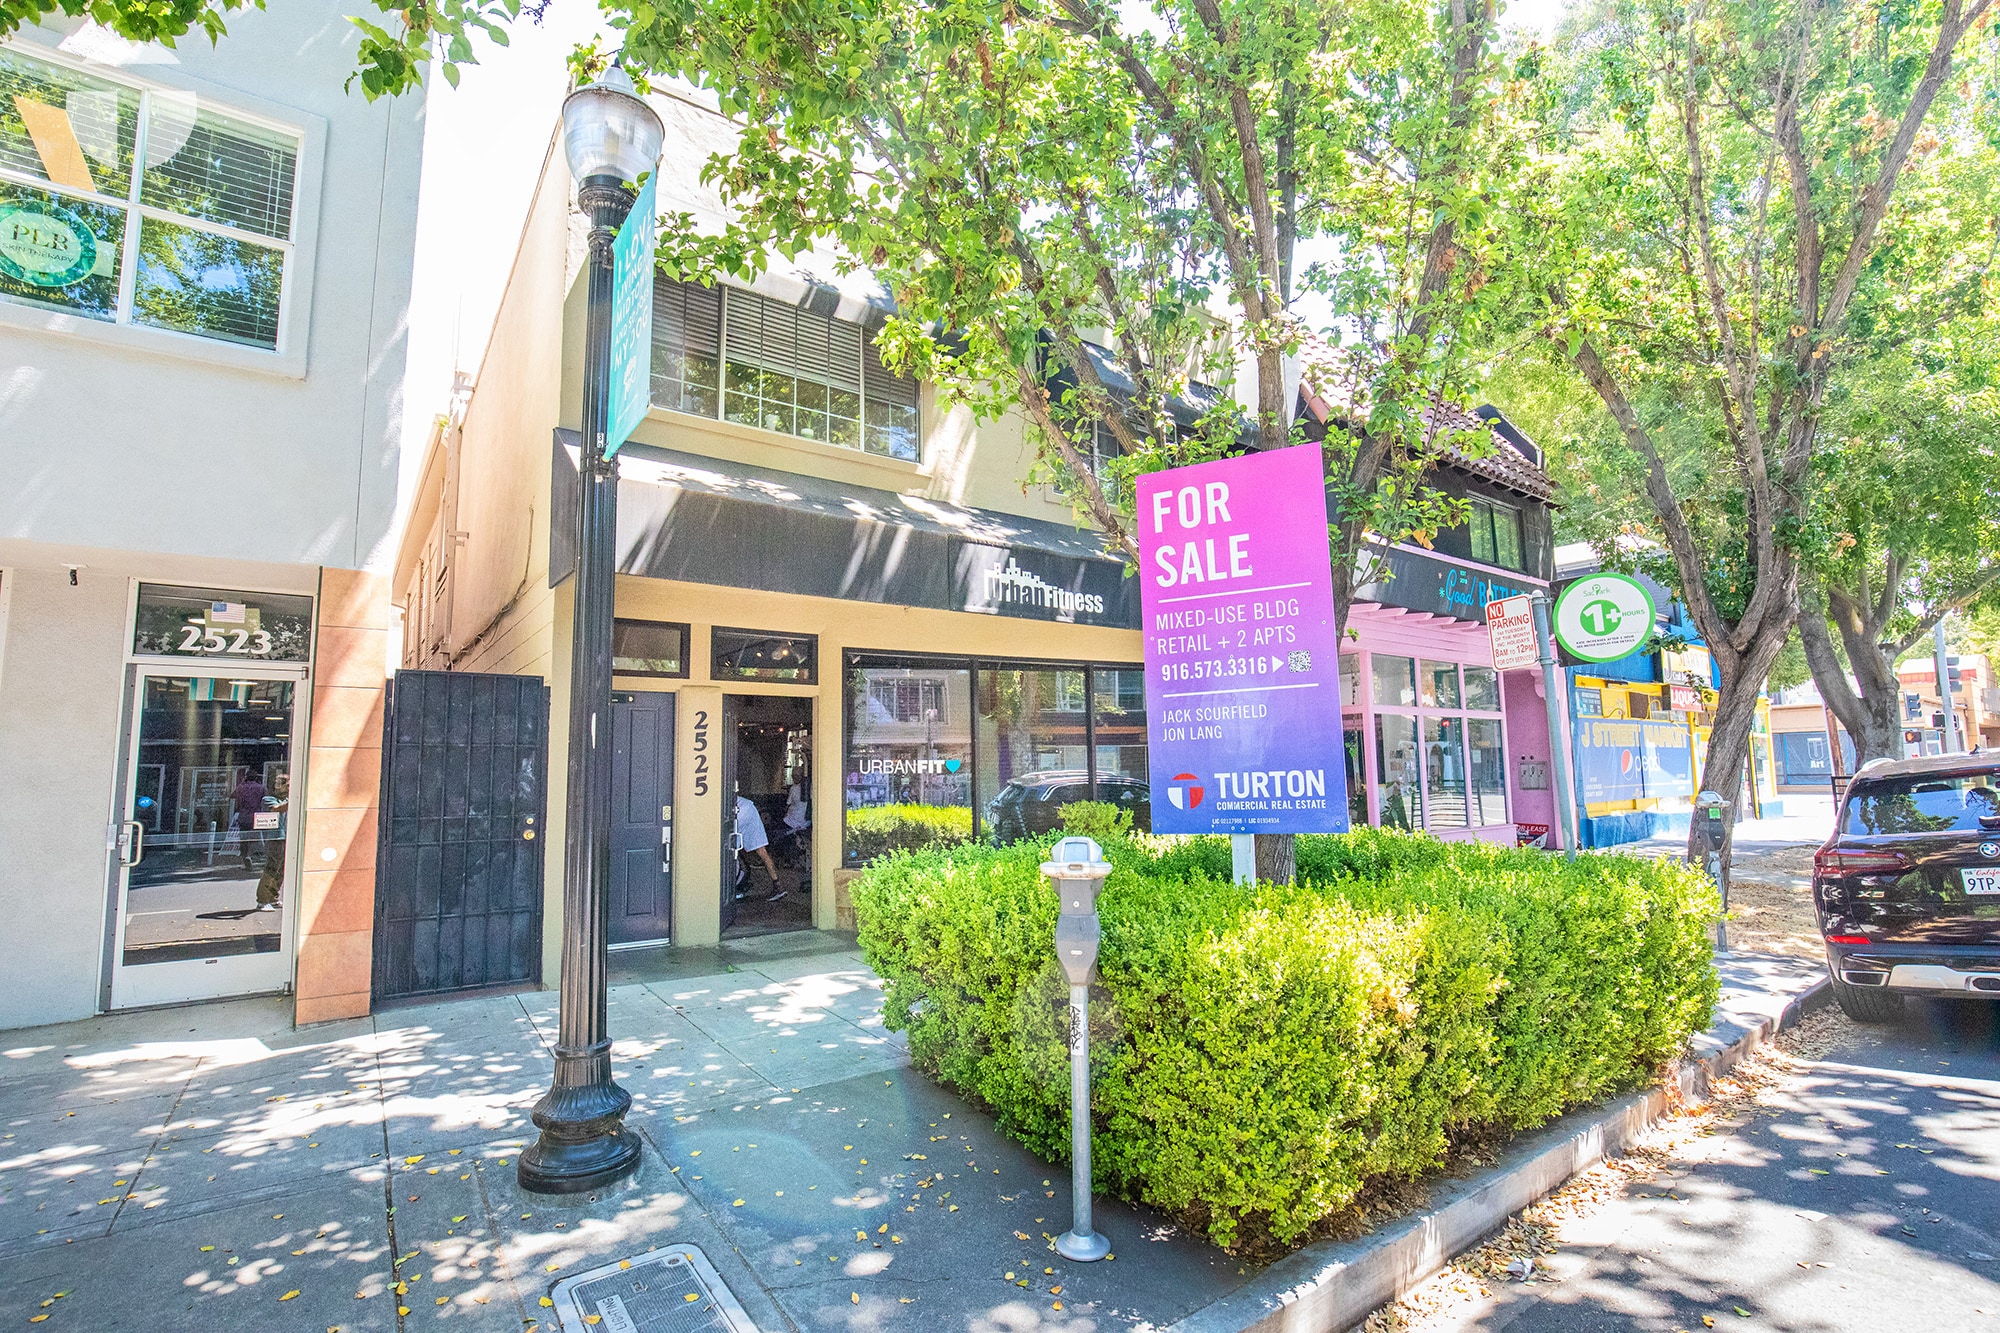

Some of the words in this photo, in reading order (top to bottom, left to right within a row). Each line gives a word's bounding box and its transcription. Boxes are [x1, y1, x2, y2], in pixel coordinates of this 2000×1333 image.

[625, 206, 653, 272] LOVE
[617, 255, 643, 305] LIVING
[1152, 481, 1232, 533] FOR
[1155, 533, 1253, 588] SALE
[1446, 569, 1477, 611] Good
[1156, 604, 1246, 631] MIXED-USE
[1253, 599, 1299, 619] BLDG
[1489, 603, 1502, 618] NO
[1492, 614, 1530, 630] PARKING
[1622, 609, 1645, 617] HOURS
[178, 625, 272, 654] 2523
[1158, 635, 1212, 655] RETAIL
[1218, 636, 1230, 649] +
[1237, 630, 1247, 648] 2
[1254, 624, 1296, 646] APTS
[1495, 648, 1508, 658] 8AM
[1516, 643, 1534, 654] 12PM
[1162, 657, 1267, 681] 916.573.3316
[1162, 708, 1192, 724] JACK
[1196, 704, 1267, 722] SCURFIELD
[1163, 727, 1185, 742] JON
[1190, 725, 1222, 741] LANG
[1581, 722, 1590, 748] J
[1592, 722, 1641, 748] STREET
[1643, 724, 1688, 749] MARKET
[693, 710, 709, 797] 2525
[859, 759, 945, 774] URBANFIT
[1635, 753, 1660, 779] pepsi
[1811, 760, 1825, 768] Art
[1214, 769, 1325, 799] TURTON
[1216, 801, 1268, 811] COMMERCIAL
[1271, 800, 1293, 810] REAL
[1295, 799, 1326, 809] ESTATE
[1526, 825, 1548, 833] LEASE
